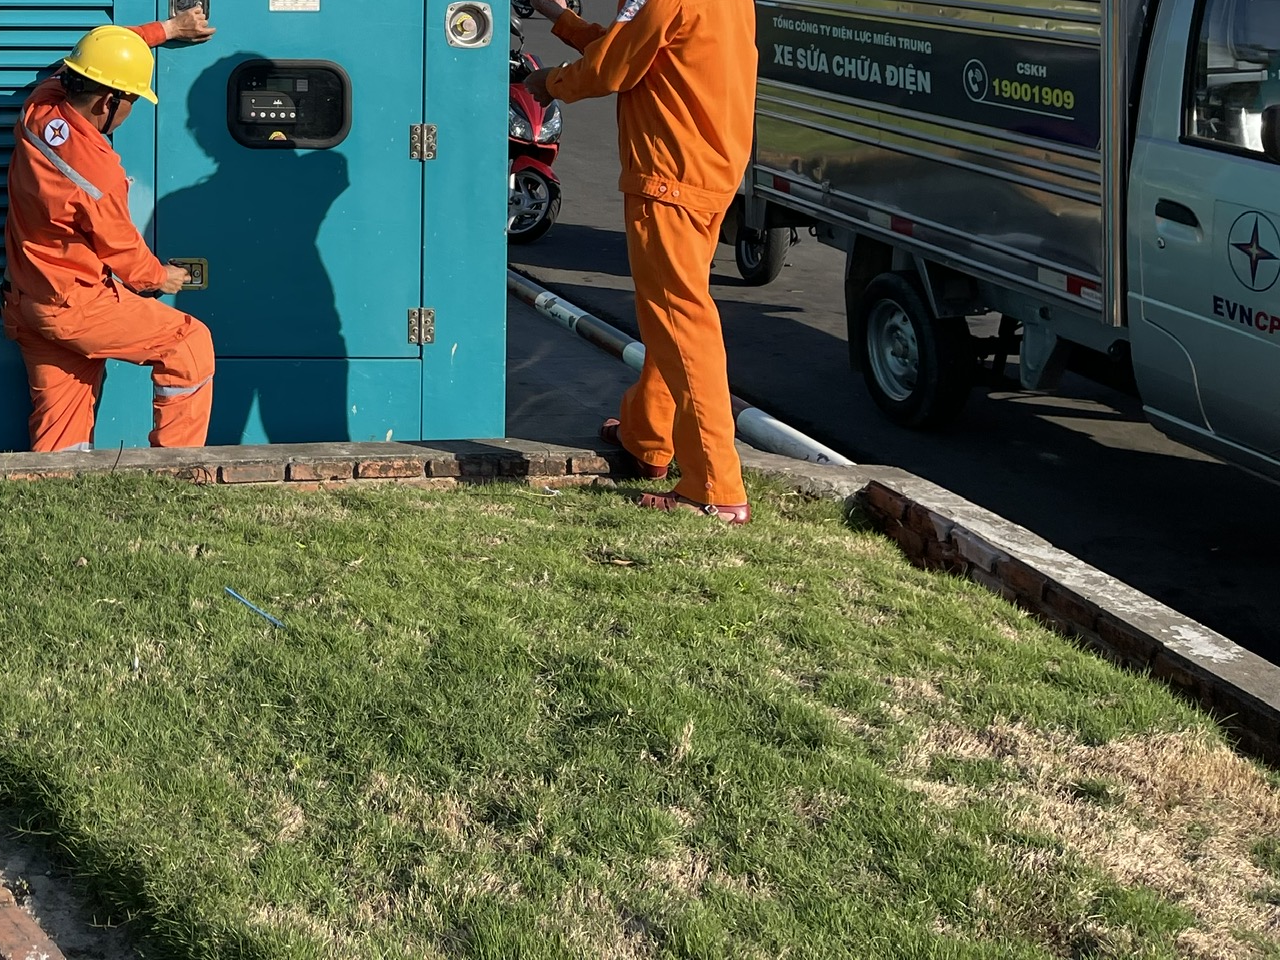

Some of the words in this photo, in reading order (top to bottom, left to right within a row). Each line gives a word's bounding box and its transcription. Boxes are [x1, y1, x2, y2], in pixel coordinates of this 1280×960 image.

[773, 14, 794, 30] TỔNG
[795, 19, 819, 35] CÔNG
[820, 24, 831, 36] TY
[832, 25, 853, 41] ĐIỆN
[854, 30, 872, 43] LỰC
[898, 37, 932, 55] TRUNG
[773, 43, 794, 67] XE
[796, 43, 829, 74] SỬA
[832, 55, 882, 84] CHỮA
[885, 63, 932, 95] ĐIỆN
[1016, 62, 1047, 78] CSKH
[992, 78, 1075, 110] 19001909
